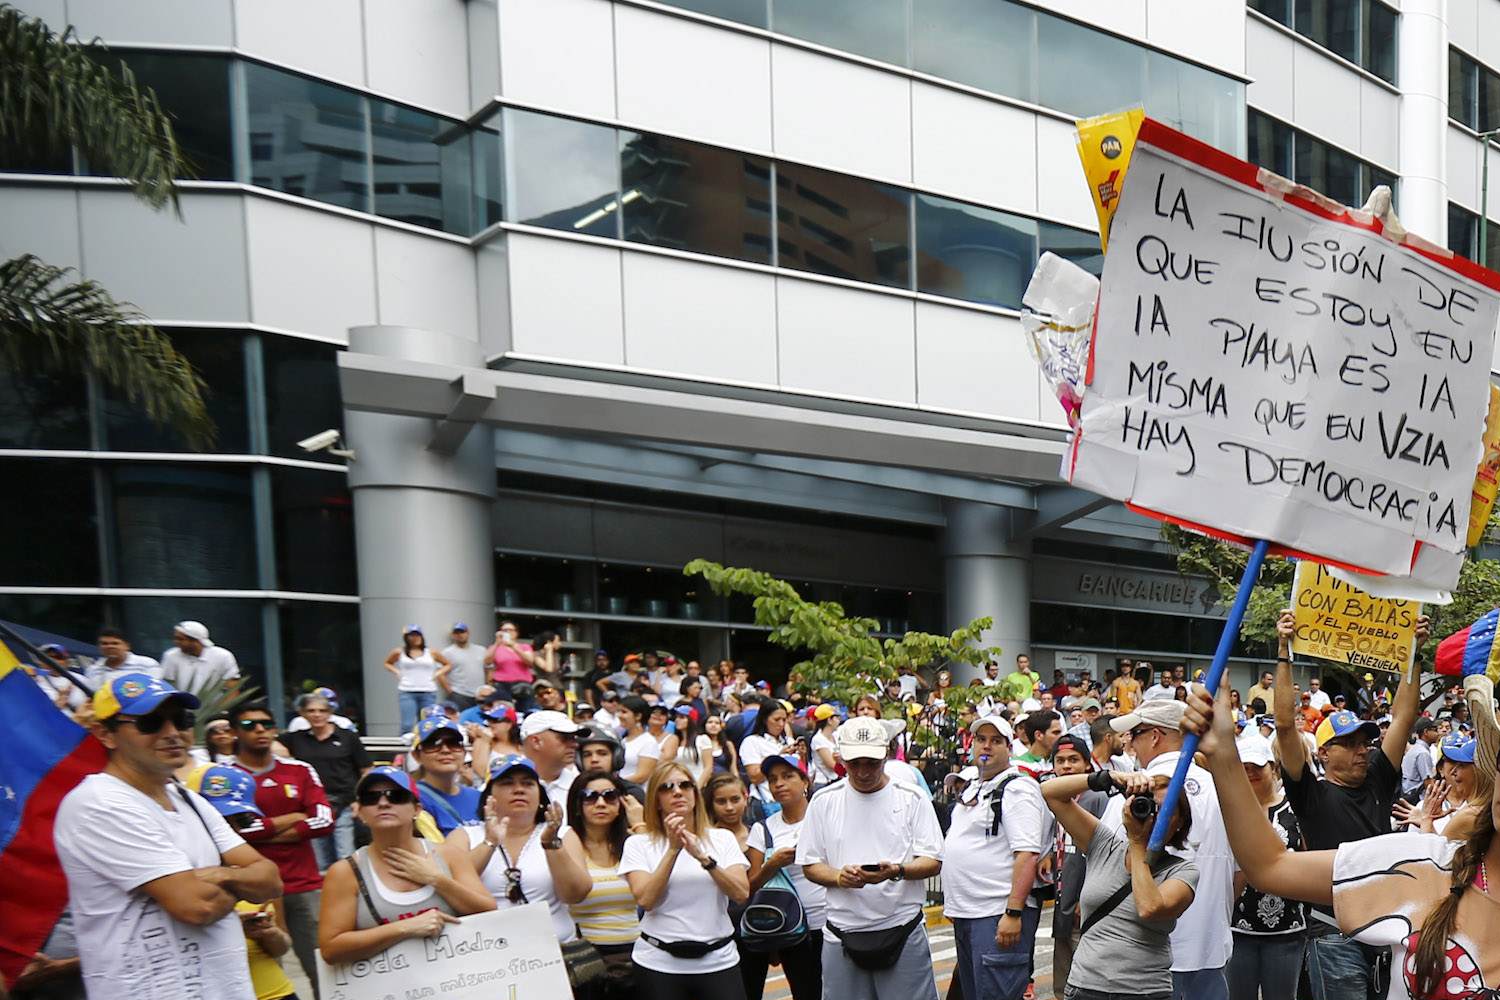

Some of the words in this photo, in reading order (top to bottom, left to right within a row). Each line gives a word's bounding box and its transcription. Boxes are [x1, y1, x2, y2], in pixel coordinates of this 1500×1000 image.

[1154, 173, 1194, 230] LA
[1402, 267, 1479, 326] DE
[1136, 234, 1221, 285] QUE
[1416, 330, 1473, 364] EN
[1339, 355, 1390, 393] ES
[1254, 398, 1306, 436] QUE
[1326, 413, 1365, 442] EN
[1079, 574, 1198, 605] BANCARIBE
[1298, 588, 1337, 613] CON
[1342, 598, 1411, 628] BALAS
[1295, 624, 1332, 646] CON
[1334, 631, 1409, 663] BOLAS
[1346, 621, 1399, 640] PUEBLO
[1345, 650, 1401, 672] VENEZUELA
[424, 931, 510, 962] Madre
[405, 986, 436, 1000] un
[439, 967, 507, 993] mismo
